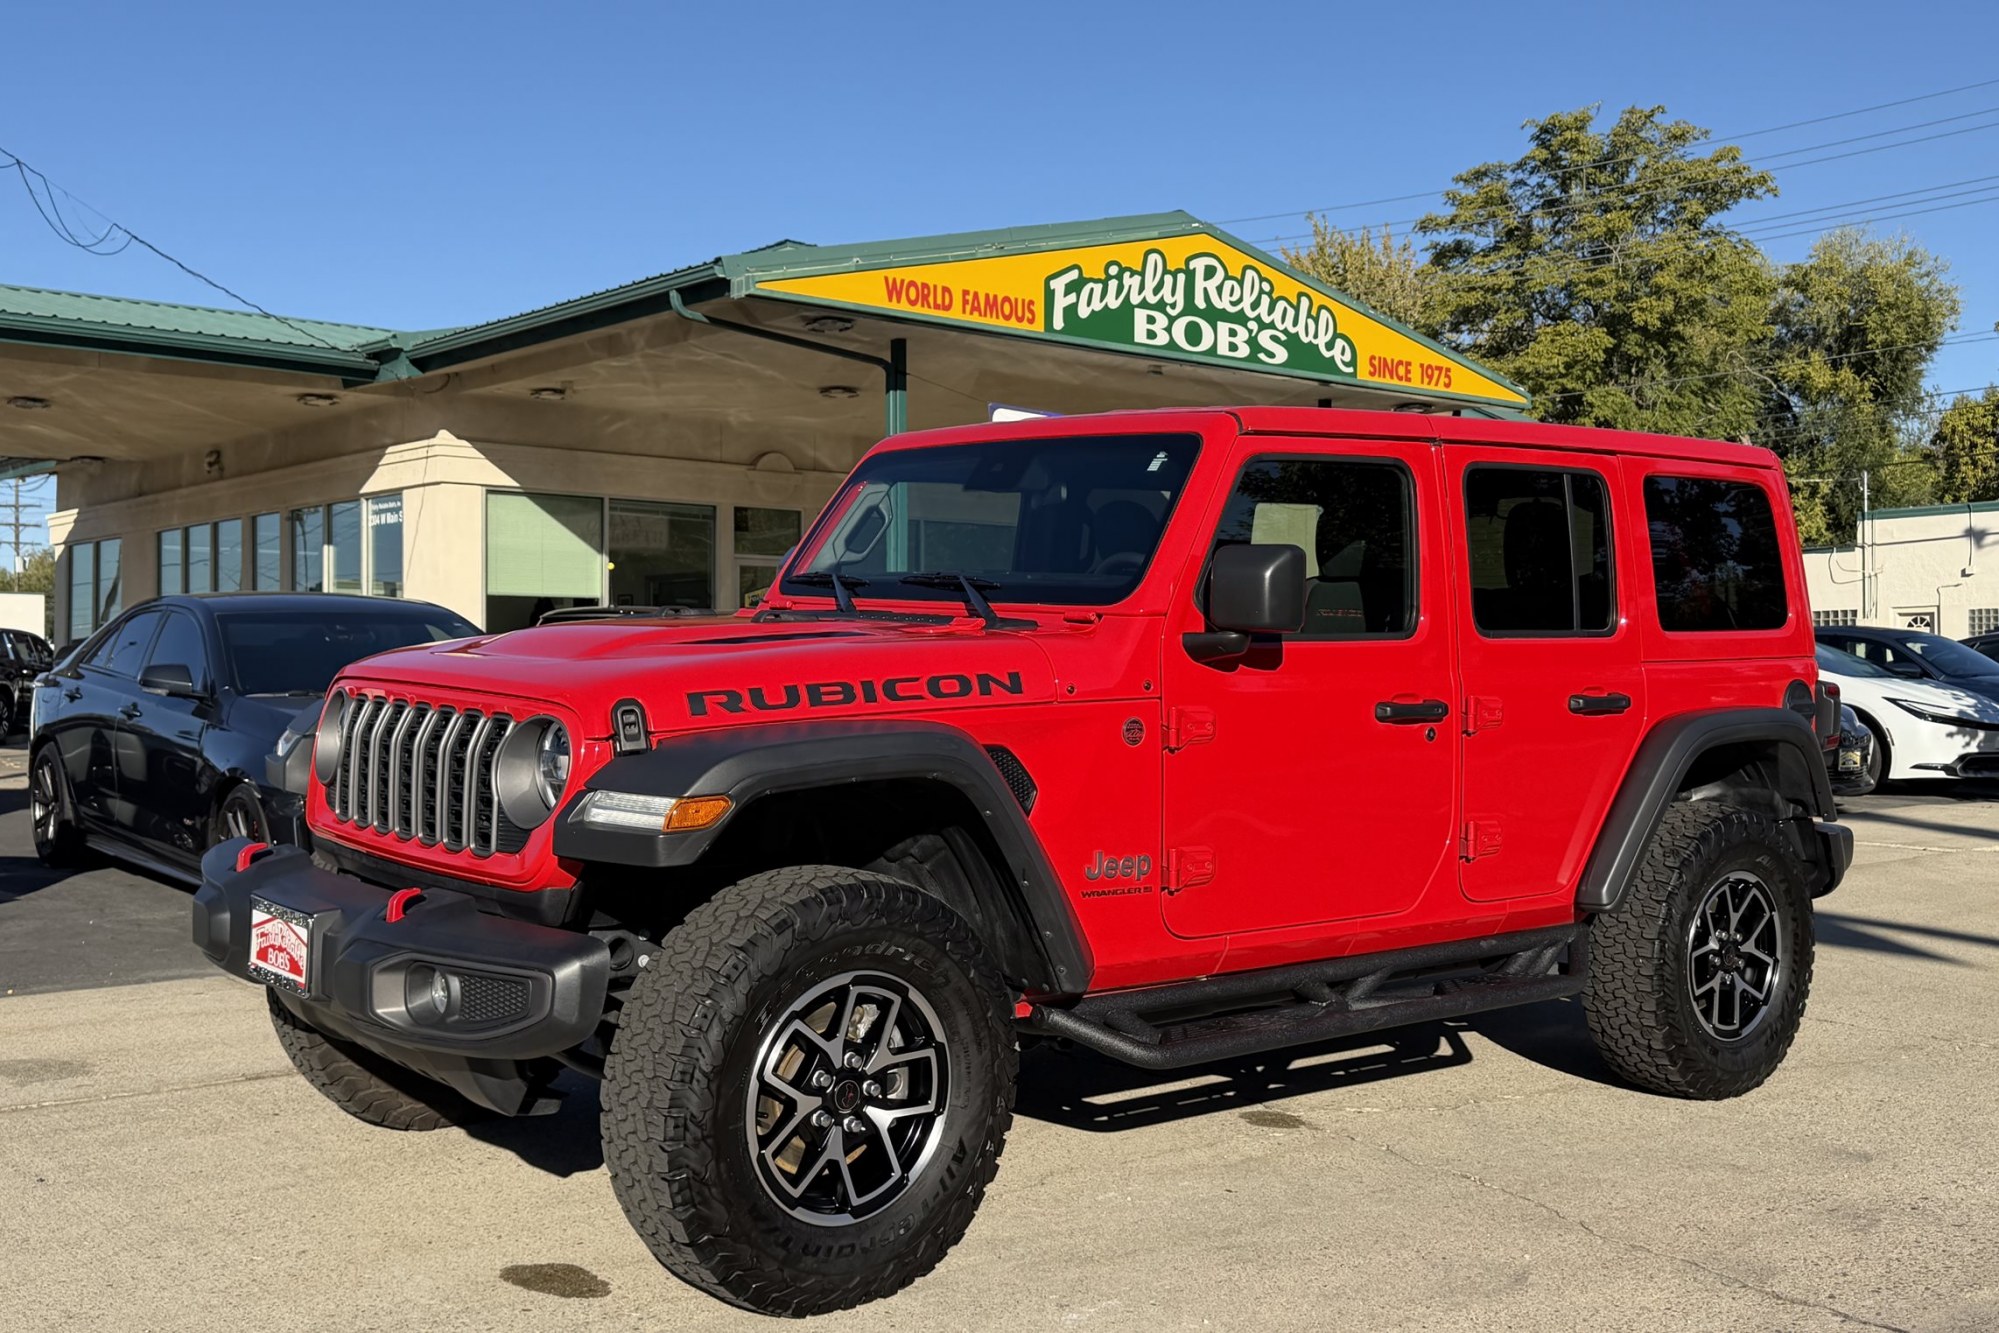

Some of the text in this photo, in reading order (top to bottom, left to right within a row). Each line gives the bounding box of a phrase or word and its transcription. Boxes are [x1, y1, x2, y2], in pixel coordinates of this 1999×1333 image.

[884, 275, 1036, 325] WORLD FAMOUS
[1050, 252, 1354, 373] Fairly Reliable
[1133, 307, 1289, 365] BOB'S
[1368, 354, 1453, 389] SINCE 1975
[686, 671, 1024, 717] RUBICON
[1085, 850, 1152, 881] Jeep
[1081, 886, 1142, 898] WRANGLER
